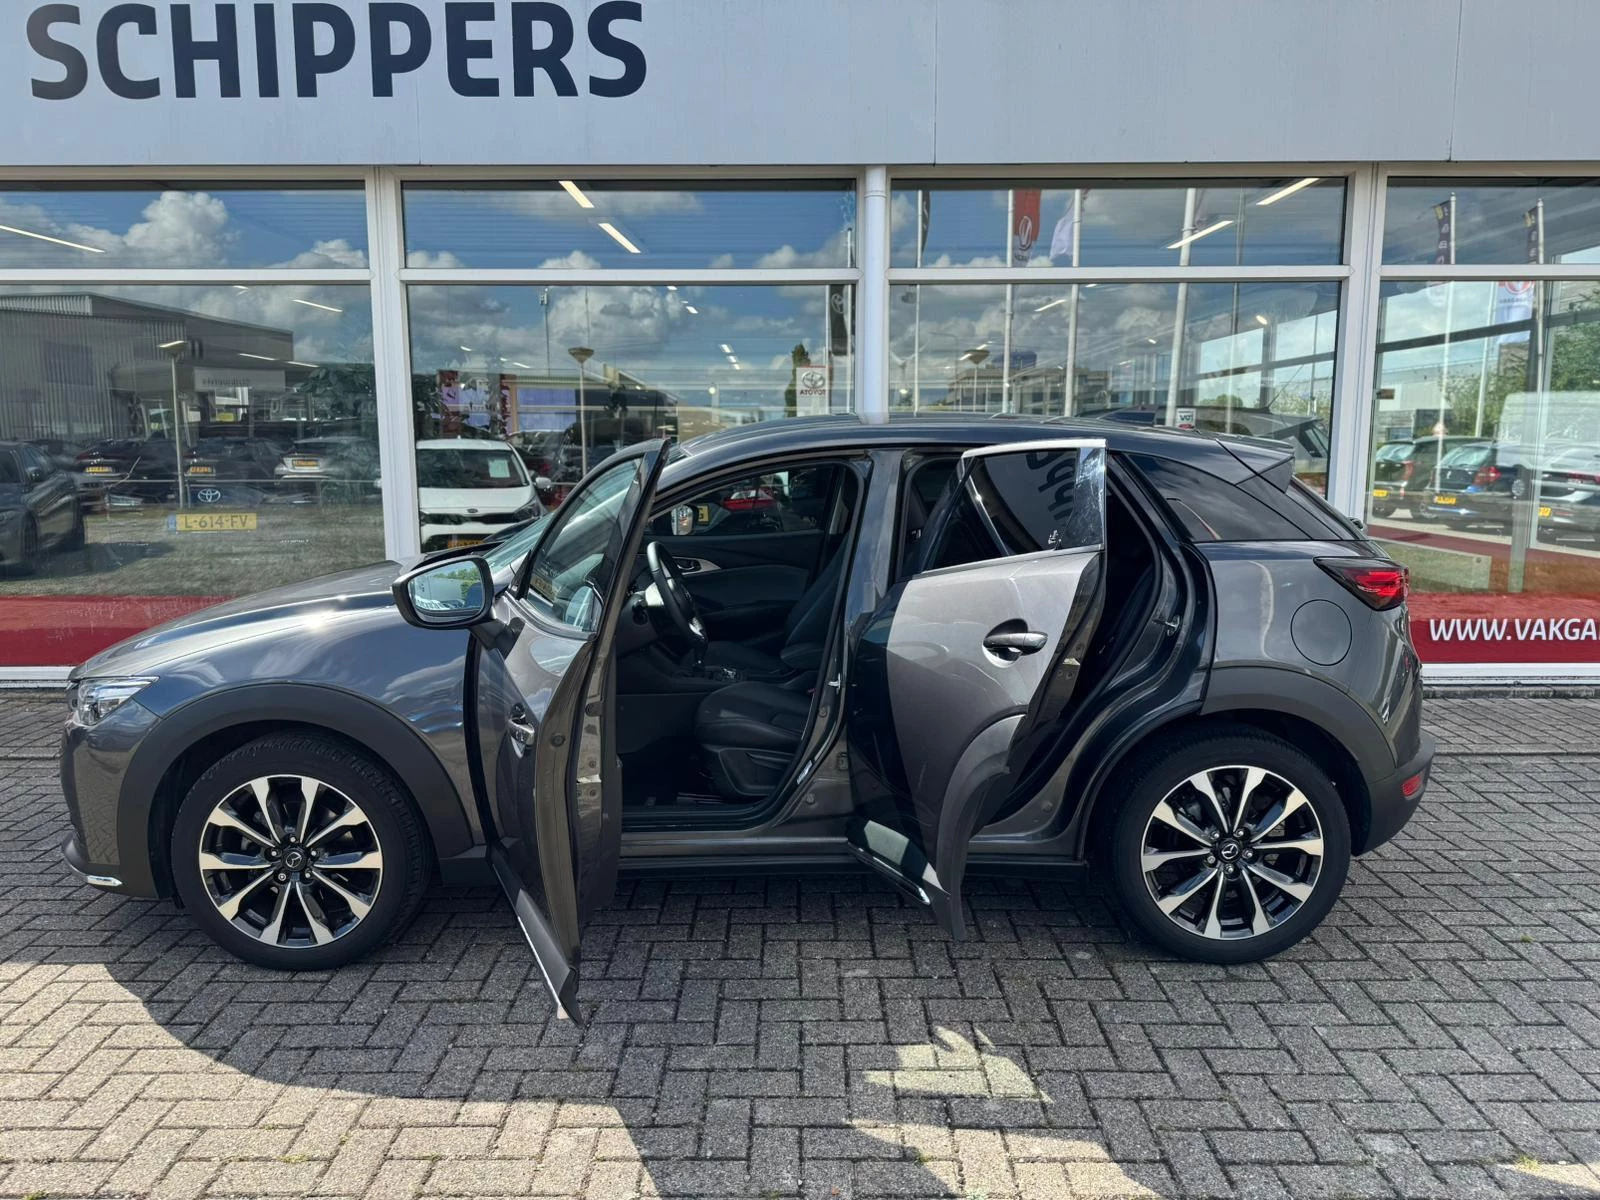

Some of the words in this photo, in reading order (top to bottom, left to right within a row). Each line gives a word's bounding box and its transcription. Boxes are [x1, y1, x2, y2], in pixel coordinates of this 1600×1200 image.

[27, 1, 647, 99] SCHIPPERS
[184, 515, 248, 529] L-614-FV
[1429, 617, 1600, 641] WWW.VAKGA
